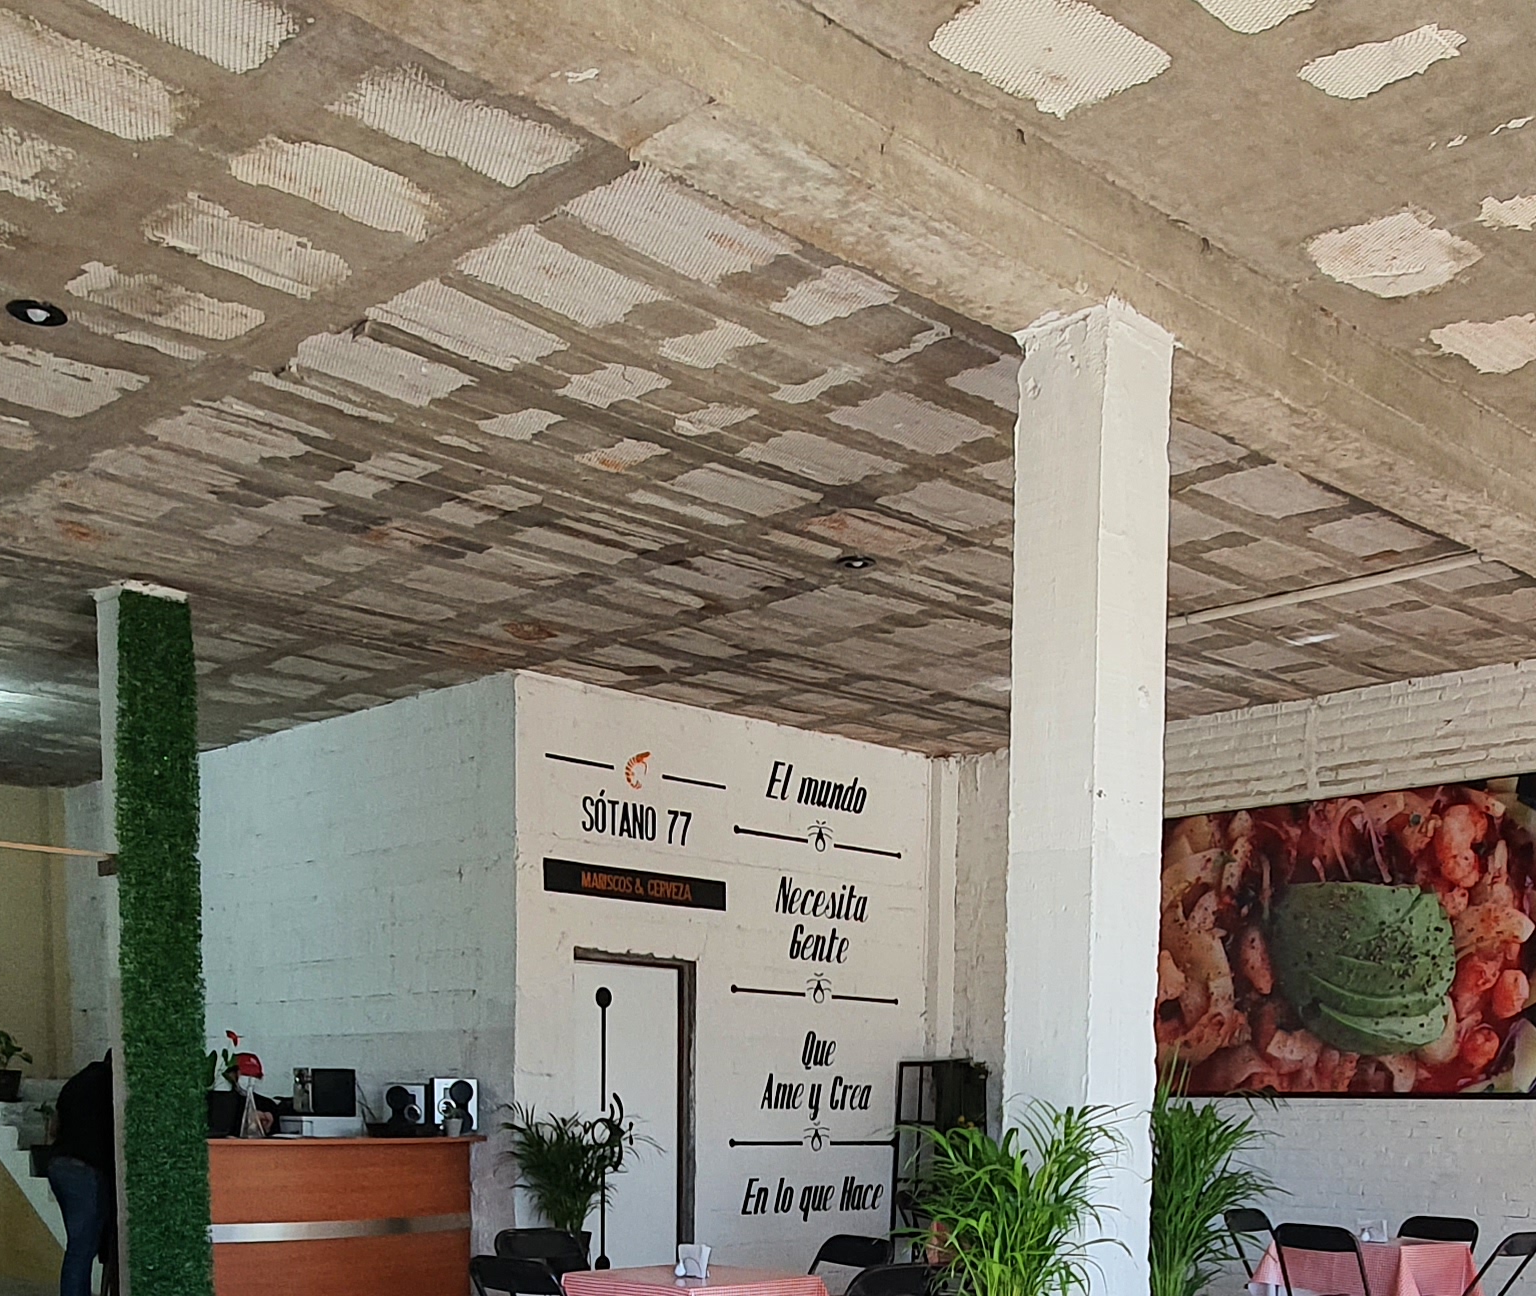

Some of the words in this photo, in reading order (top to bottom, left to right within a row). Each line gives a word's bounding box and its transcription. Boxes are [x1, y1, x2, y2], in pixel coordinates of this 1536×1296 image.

[766, 761, 793, 800] El
[797, 777, 867, 814] mundo
[582, 790, 656, 841] SÓTANO
[668, 810, 691, 846] 77
[581, 871, 633, 894] MARISCOS
[635, 878, 645, 896] &
[647, 878, 693, 902] CERVEZA
[775, 877, 867, 922] Necesita
[790, 924, 849, 963] Gente
[802, 1031, 836, 1070] Que
[761, 1073, 804, 1109] Ame
[809, 1084, 822, 1121] y
[830, 1076, 872, 1110] Crea
[741, 1178, 768, 1215] En
[774, 1178, 794, 1213] lo
[799, 1186, 835, 1222] que
[840, 1176, 883, 1211] Hace
